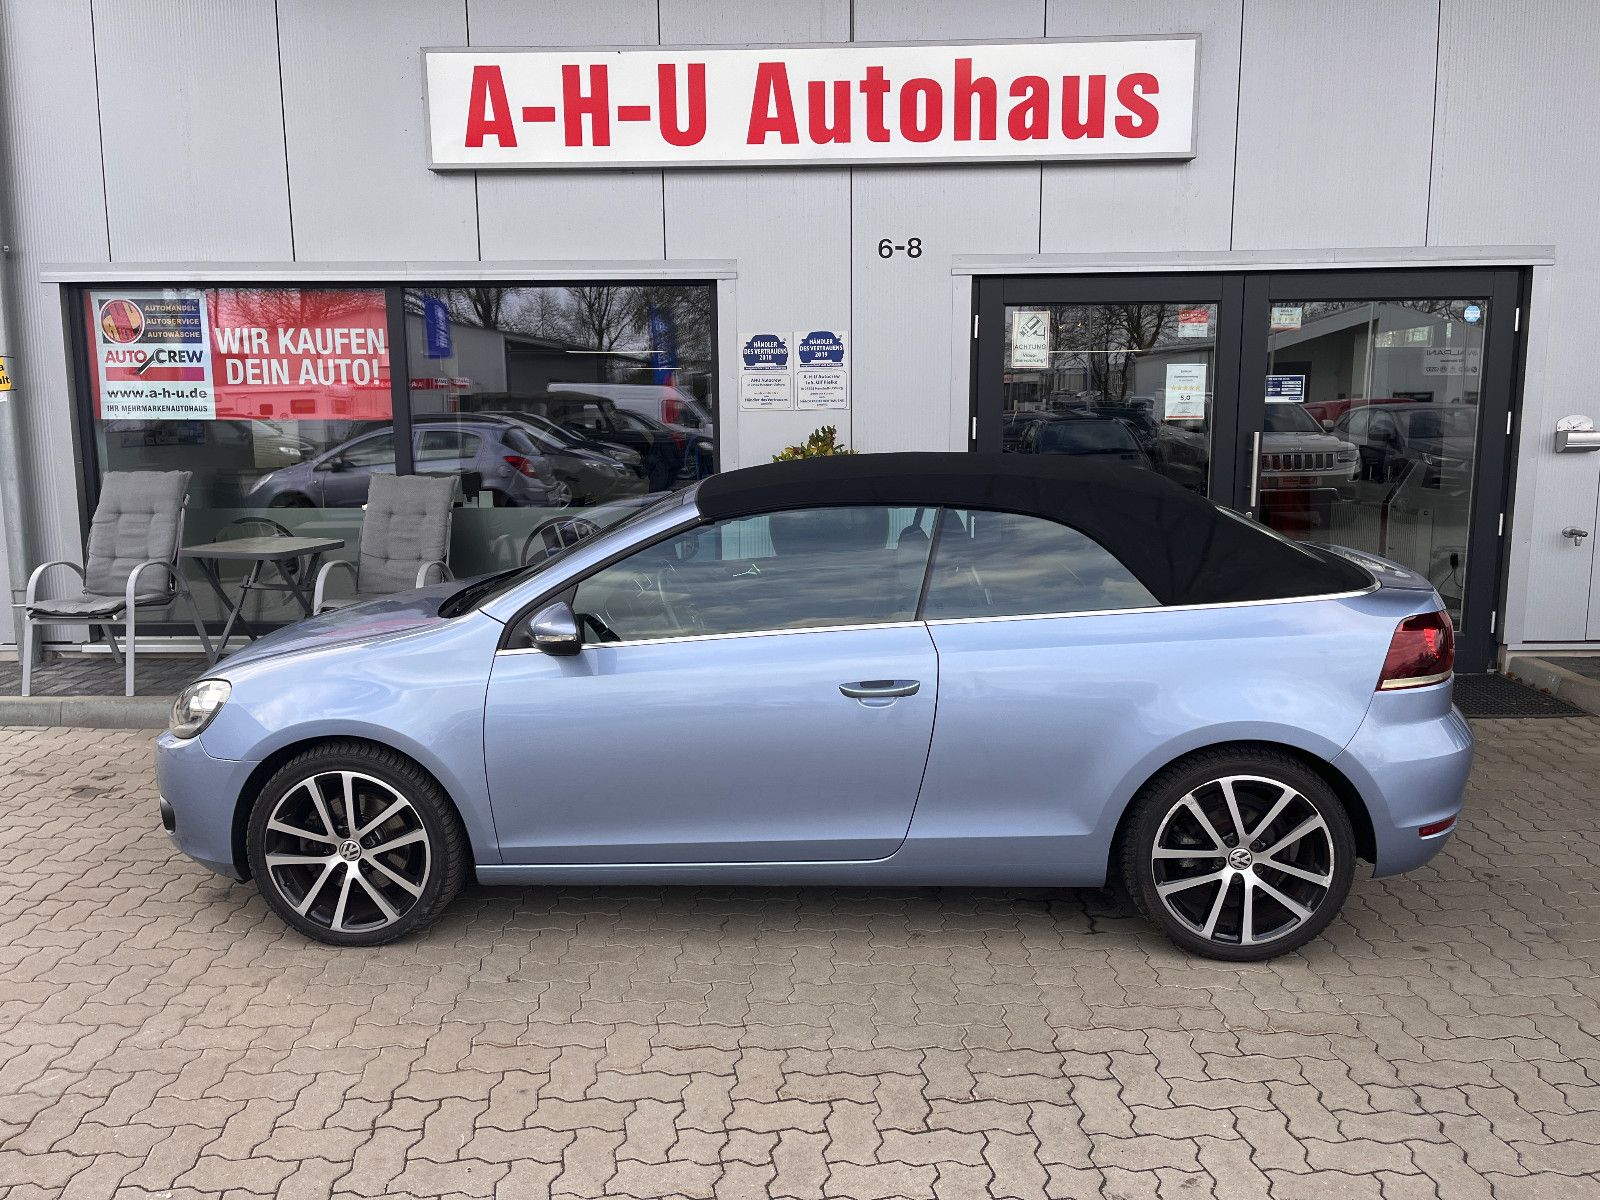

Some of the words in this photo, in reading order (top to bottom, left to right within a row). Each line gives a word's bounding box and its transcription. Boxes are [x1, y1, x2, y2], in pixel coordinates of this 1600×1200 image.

[465, 63, 706, 148] A-H-U
[746, 57, 1159, 147] Autohaus
[878, 237, 922, 258] 6-8
[144, 304, 196, 312] AUTOHANDEL
[146, 317, 200, 325] AUTOSERVICE
[147, 329, 201, 338] AUTOWÄSCHE
[215, 327, 270, 354] WIR
[278, 327, 385, 354] KAUFEN
[105, 349, 147, 363] AUTO
[154, 348, 204, 363] CREW
[226, 358, 289, 385] DEIN
[299, 358, 380, 385] AUTO!
[107, 387, 208, 399] www.a-h-u.de
[107, 404, 119, 412] IHR
[121, 404, 208, 412] MEHRMARKENAUTOHAUS
